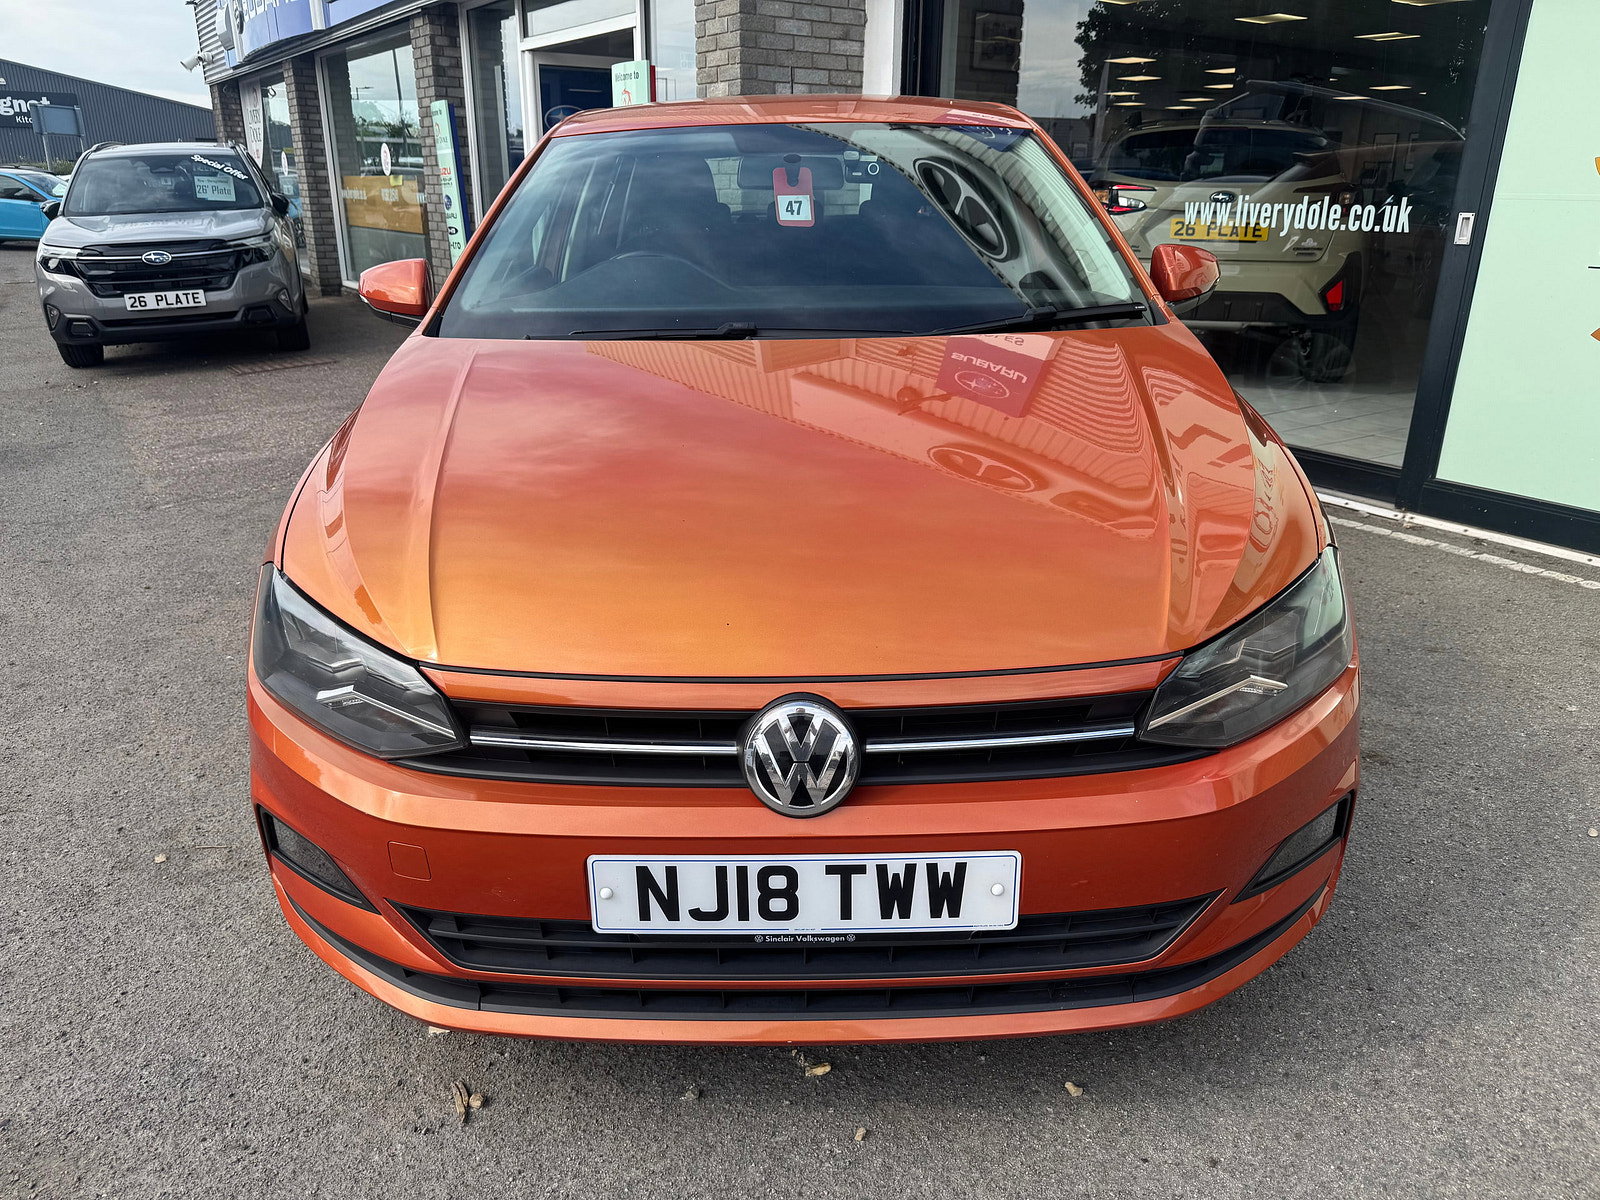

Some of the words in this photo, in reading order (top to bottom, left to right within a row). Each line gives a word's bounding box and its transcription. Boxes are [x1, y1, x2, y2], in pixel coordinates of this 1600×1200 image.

[633, 70, 640, 80] to
[191, 154, 226, 170] Special
[223, 166, 249, 180] Offer
[785, 200, 803, 216] 47
[1184, 195, 1413, 237] www.liverydole.co.uk
[1174, 221, 1196, 237] 26
[128, 295, 148, 309] 26
[155, 292, 202, 307] PLATE
[635, 865, 800, 922] NJ18
[825, 862, 968, 921] TWW
[765, 935, 794, 943] Sinclair
[796, 934, 846, 944] Volkswagen
